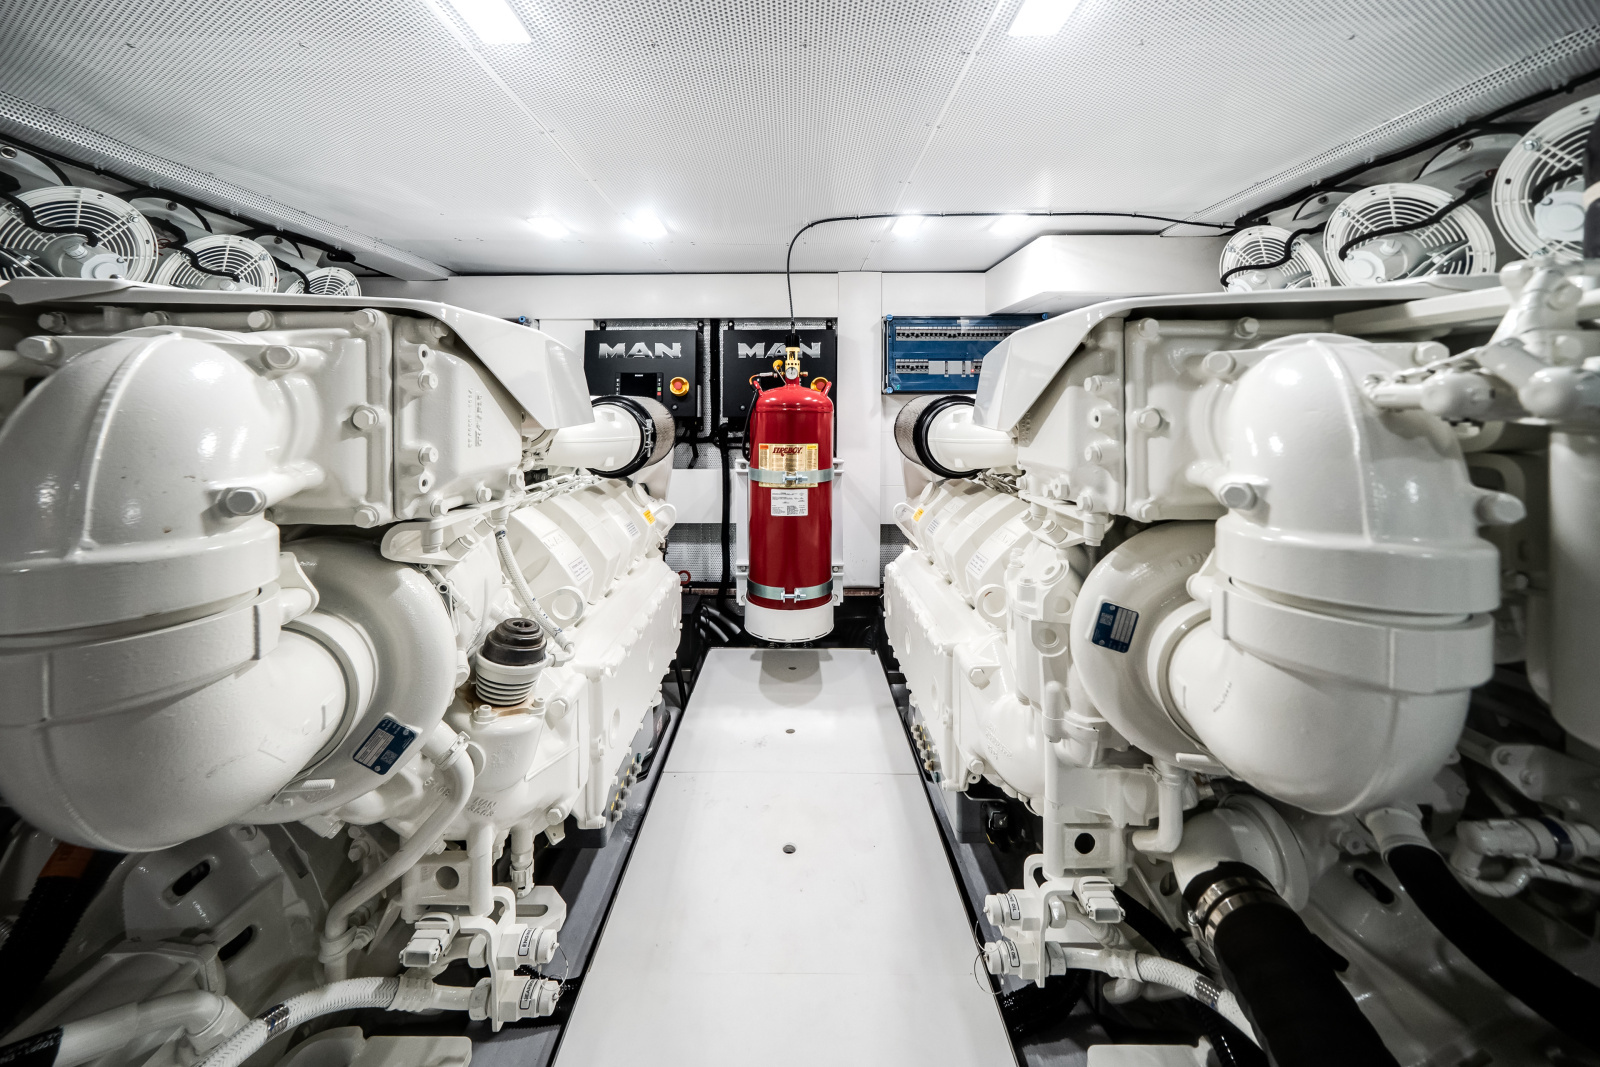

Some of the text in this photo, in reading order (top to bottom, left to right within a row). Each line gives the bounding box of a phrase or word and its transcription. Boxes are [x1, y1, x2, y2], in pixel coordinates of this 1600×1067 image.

[599, 342, 681, 358] MAN
[738, 342, 821, 358] MAN
[772, 446, 803, 457] FIREBOY
